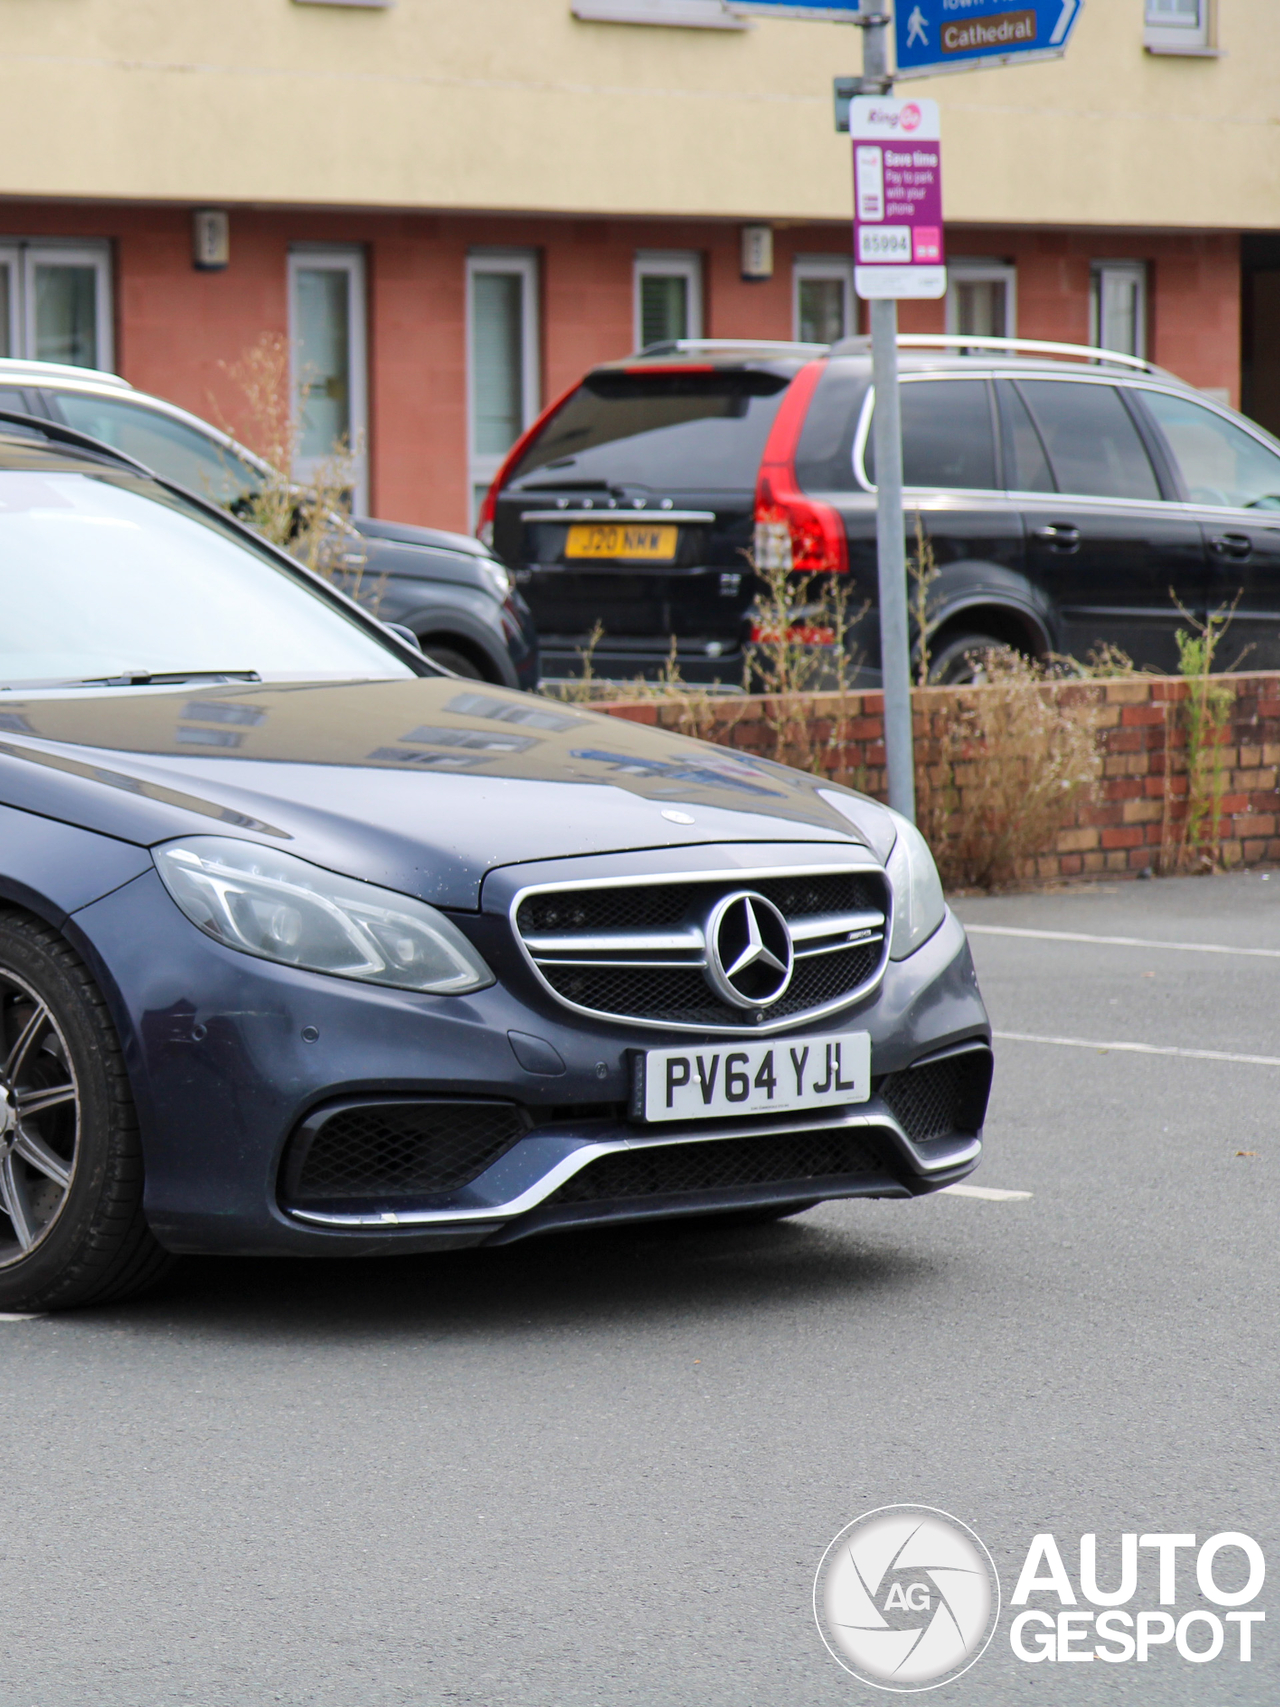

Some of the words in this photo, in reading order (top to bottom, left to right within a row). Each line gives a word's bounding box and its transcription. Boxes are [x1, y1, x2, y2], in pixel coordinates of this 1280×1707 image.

[945, 17, 1032, 48] Cathedral
[885, 150, 912, 167] Save
[913, 150, 938, 167] time
[885, 169, 902, 185] Pay
[904, 170, 913, 184] to
[914, 171, 934, 186] park
[886, 187, 906, 199] with
[907, 187, 926, 201] your
[886, 203, 915, 217] phone
[666, 1050, 777, 1108] PV64
[790, 1042, 855, 1097] YJL
